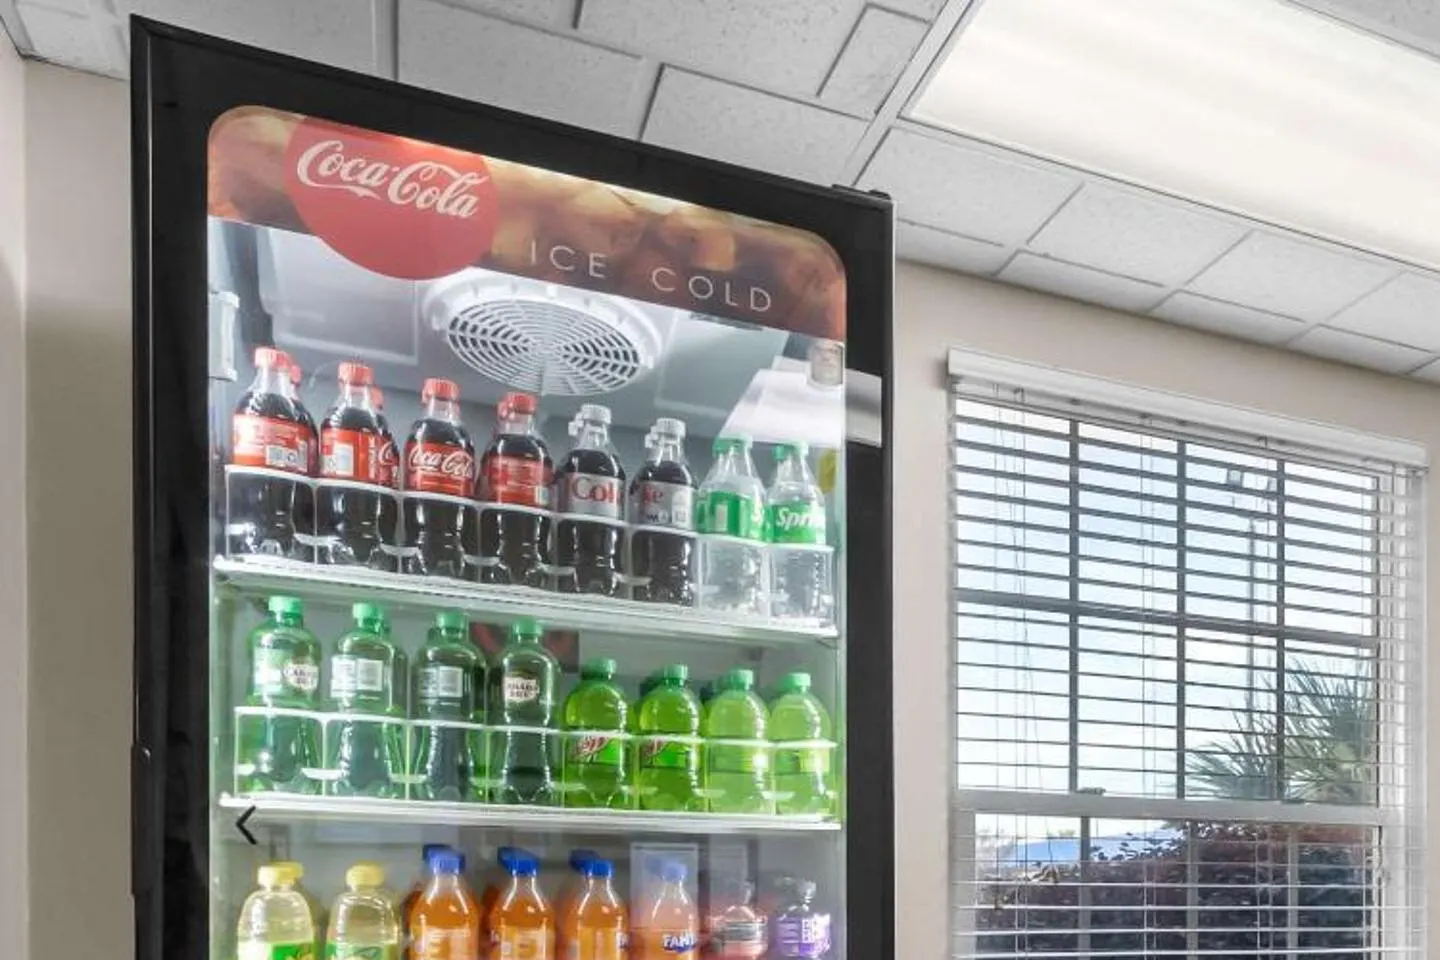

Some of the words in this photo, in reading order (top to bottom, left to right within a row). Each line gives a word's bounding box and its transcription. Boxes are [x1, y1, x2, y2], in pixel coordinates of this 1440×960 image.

[297, 140, 489, 218] Coca-Cola
[530, 240, 606, 279] ICE
[651, 265, 772, 313] COLD
